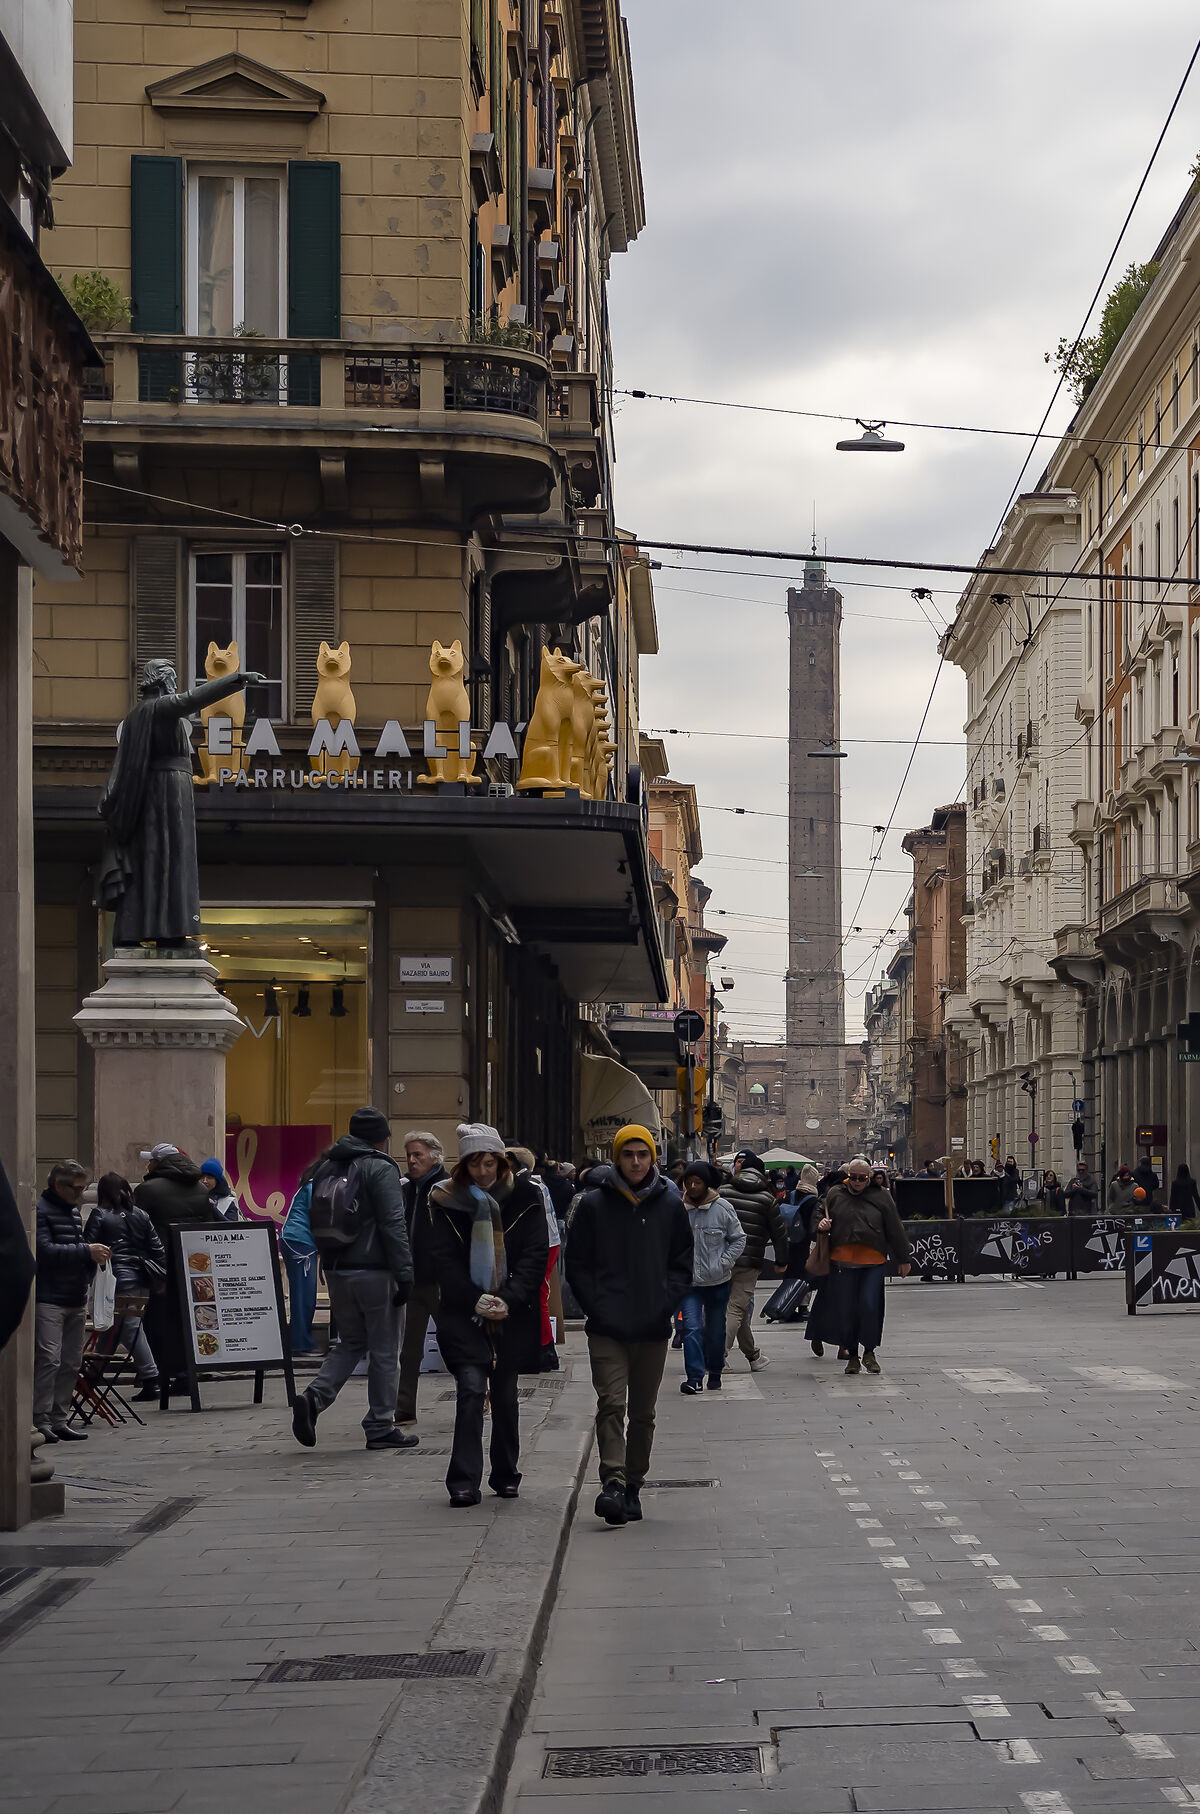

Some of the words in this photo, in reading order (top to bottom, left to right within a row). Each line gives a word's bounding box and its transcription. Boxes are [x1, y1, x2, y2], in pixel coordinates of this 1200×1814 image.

[218, 767, 414, 790] PARRUCCHIERI
[230, 1233, 245, 1241] MIA
[1014, 1231, 1053, 1253] DAYS
